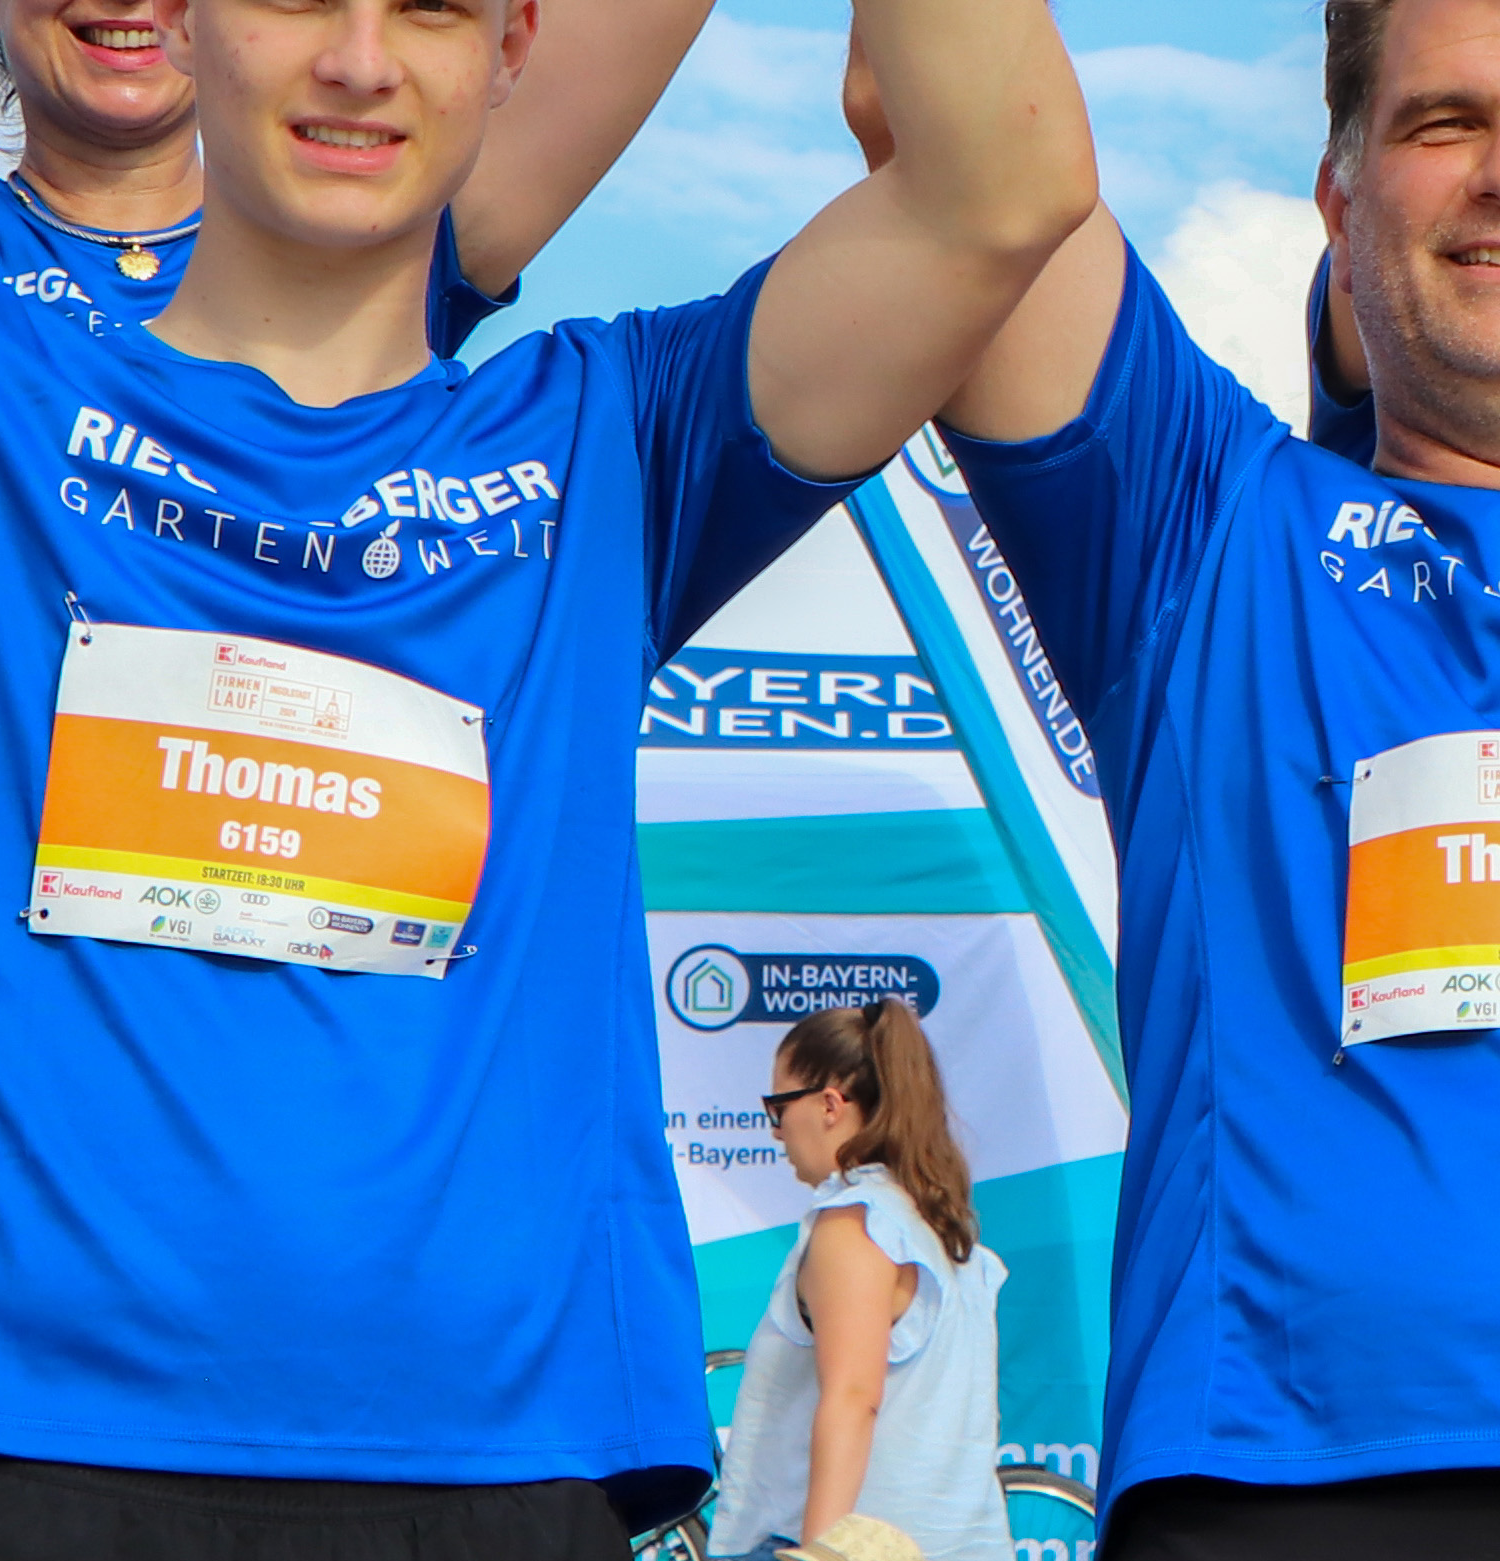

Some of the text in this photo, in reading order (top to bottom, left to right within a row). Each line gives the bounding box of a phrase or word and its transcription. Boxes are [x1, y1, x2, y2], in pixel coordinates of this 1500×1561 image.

[60, 476, 556, 575] GARTEN WELT
[238, 654, 286, 671] Kaufland
[967, 524, 1095, 785] WOHNEN.DE
[216, 675, 262, 691] FIRMEN
[214, 689, 259, 710] LAUF
[157, 736, 382, 819] Thomas
[219, 820, 301, 859] 6159
[201, 866, 306, 891] STARTZEIT: 18:30 UHR
[63, 882, 124, 900] Kaufland
[138, 885, 193, 908] AOK
[168, 919, 193, 935] VGI
[213, 932, 266, 947] GALAXY
[762, 964, 918, 989] IN-BAYERN-
[1371, 984, 1425, 1004] Kaufland
[1441, 973, 1493, 993] AOK
[1473, 1002, 1497, 1016] VGI
